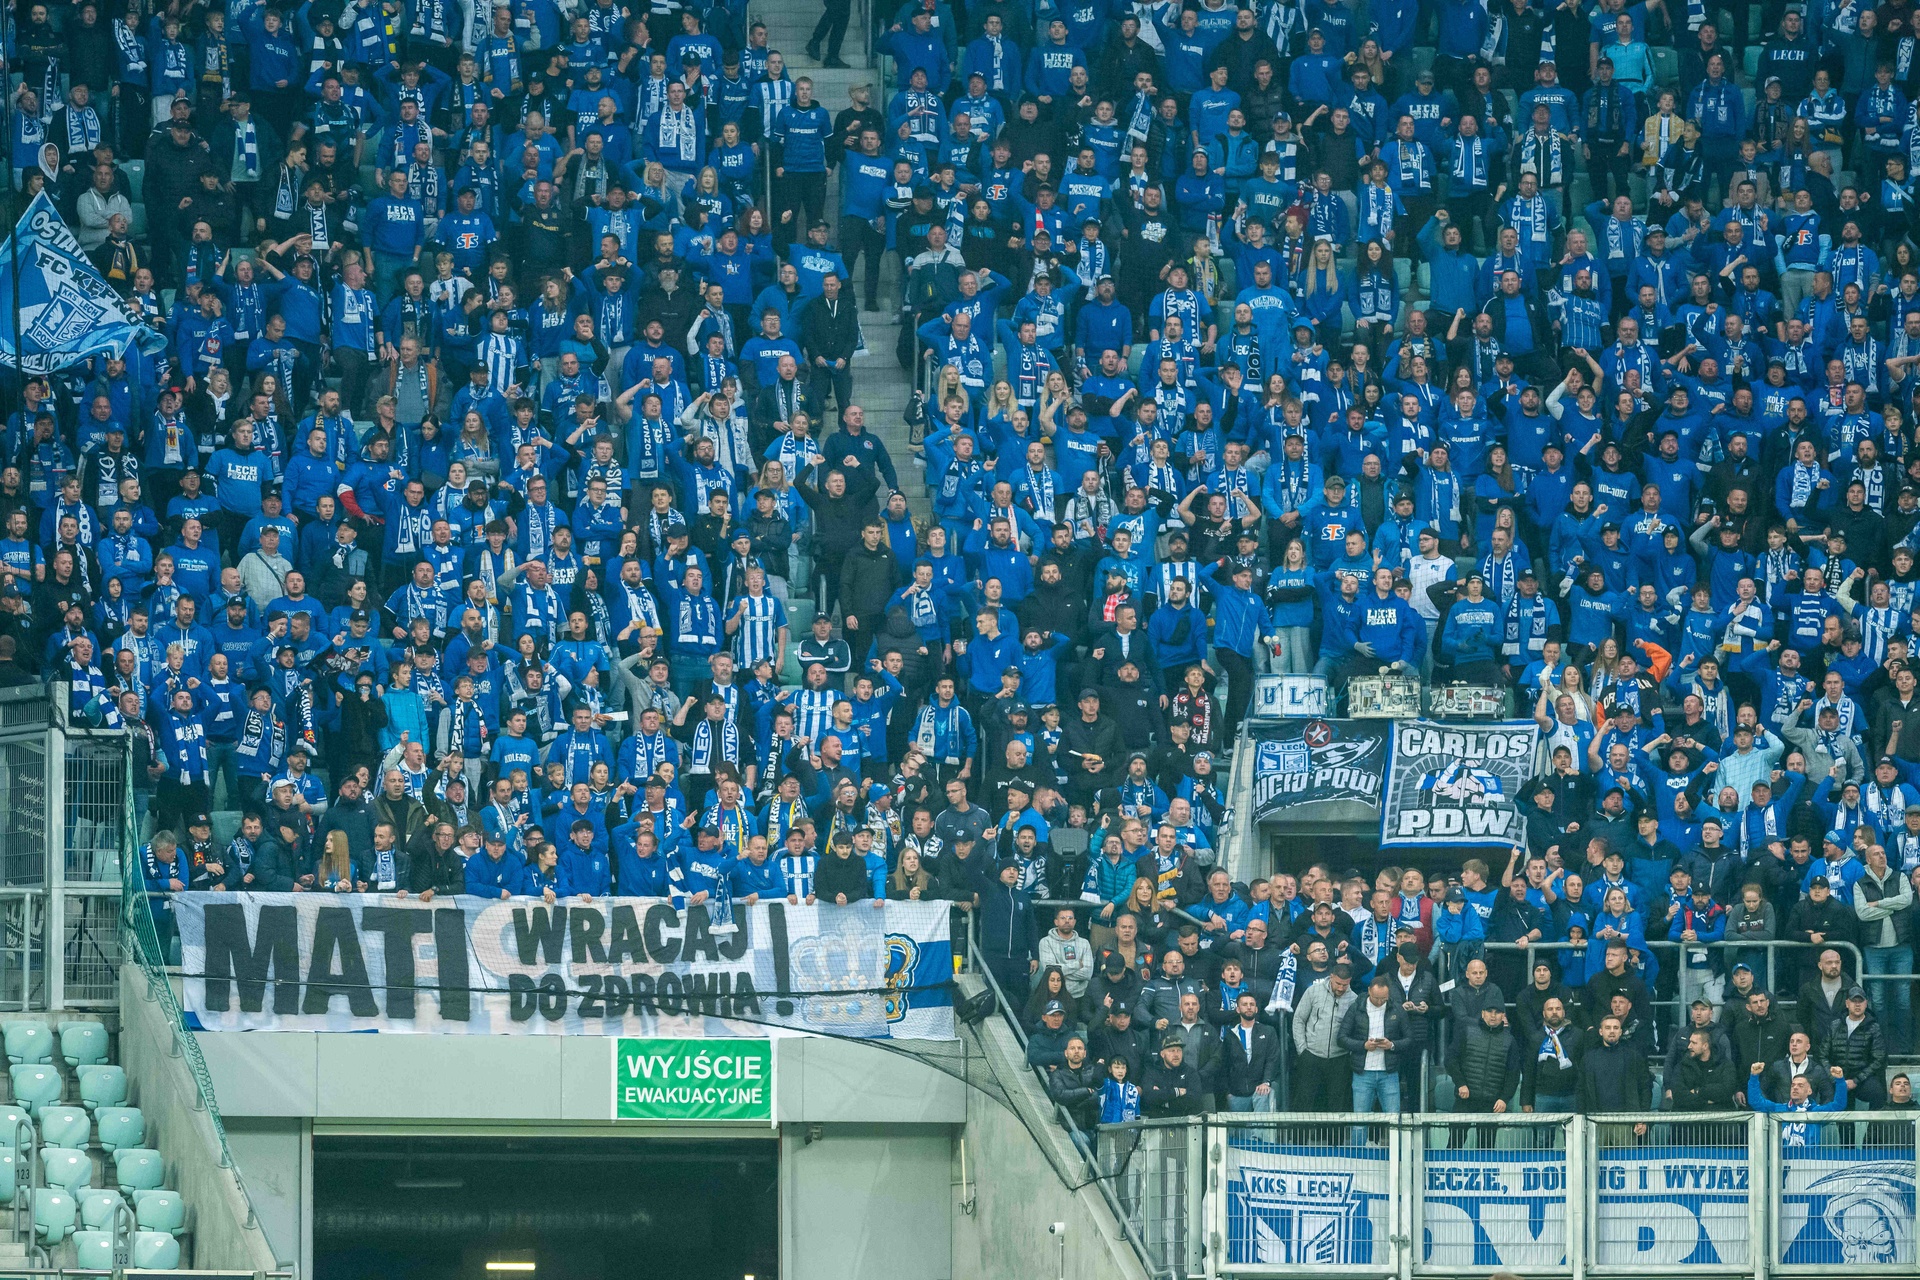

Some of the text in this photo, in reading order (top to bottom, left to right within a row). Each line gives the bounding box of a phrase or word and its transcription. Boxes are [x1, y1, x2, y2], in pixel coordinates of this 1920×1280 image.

[1043, 53, 1073, 61] LECH
[1773, 50, 1804, 60] LECH
[1410, 105, 1439, 113] LECH
[1090, 138, 1118, 147] SUPERBET
[986, 184, 1008, 200] STS
[387, 205, 414, 214] LECH
[456, 233, 478, 249] STS
[1798, 230, 1812, 245] TS
[36, 252, 68, 276] FC
[61, 287, 99, 318] KKS LECH
[228, 463, 257, 475] LECH
[1321, 524, 1345, 540] STS
[553, 568, 578, 577] ECH
[1367, 609, 1396, 618] LECH
[1281, 742, 1306, 751] LECH
[1400, 727, 1530, 759] CARLOS
[1253, 769, 1378, 809] UCIO PDW
[1397, 807, 1514, 837] PDW
[204, 903, 470, 1021] MATI
[512, 903, 748, 966] WRACAJ
[508, 971, 761, 1022] DO ZDROWIA
[626, 1049, 762, 1080] WYJŚCIE
[624, 1087, 763, 1105] EWAKUACYJNE
[16, 1169, 30, 1180] 123
[1424, 1166, 1509, 1195] ECZE,
[1251, 1176, 1344, 1199] KKS LECH
[114, 1253, 129, 1265] 123
